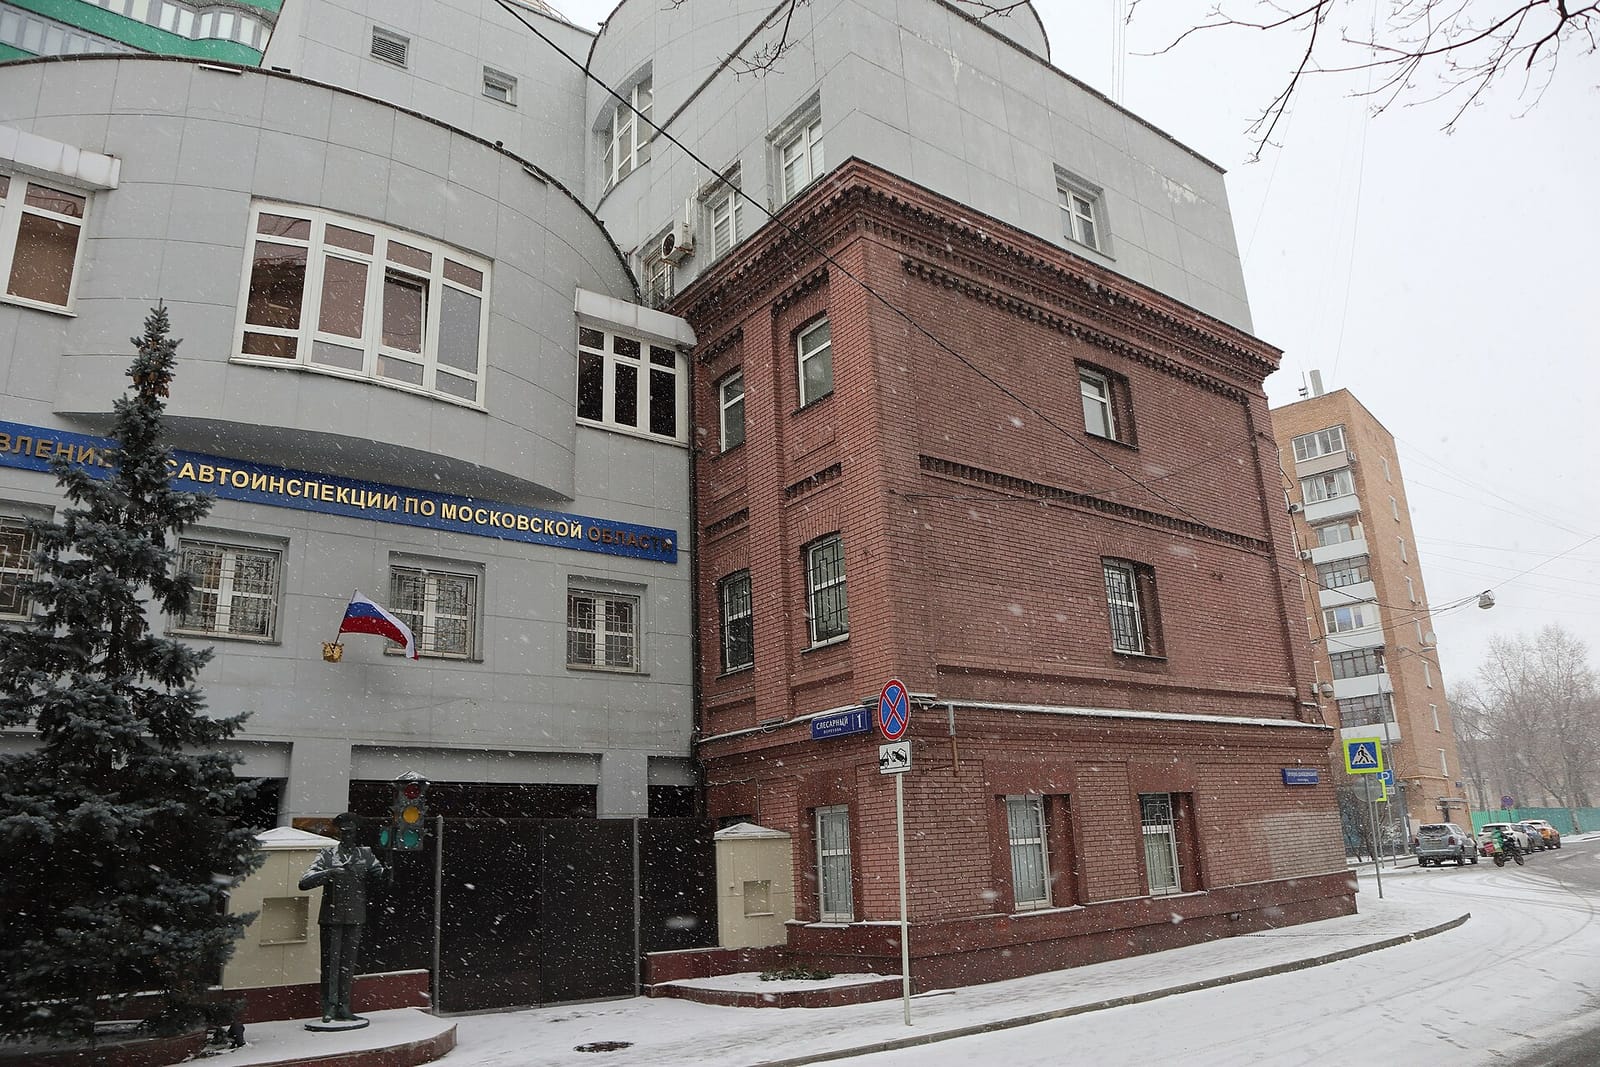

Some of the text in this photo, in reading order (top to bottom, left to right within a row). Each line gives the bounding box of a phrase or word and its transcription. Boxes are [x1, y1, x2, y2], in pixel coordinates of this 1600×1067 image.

[404, 498, 436, 517] ПО
[441, 503, 583, 540] МОСКОВСКОЙ
[816, 715, 849, 731] СЛЕСАРНЫЙ
[856, 713, 862, 729] 1
